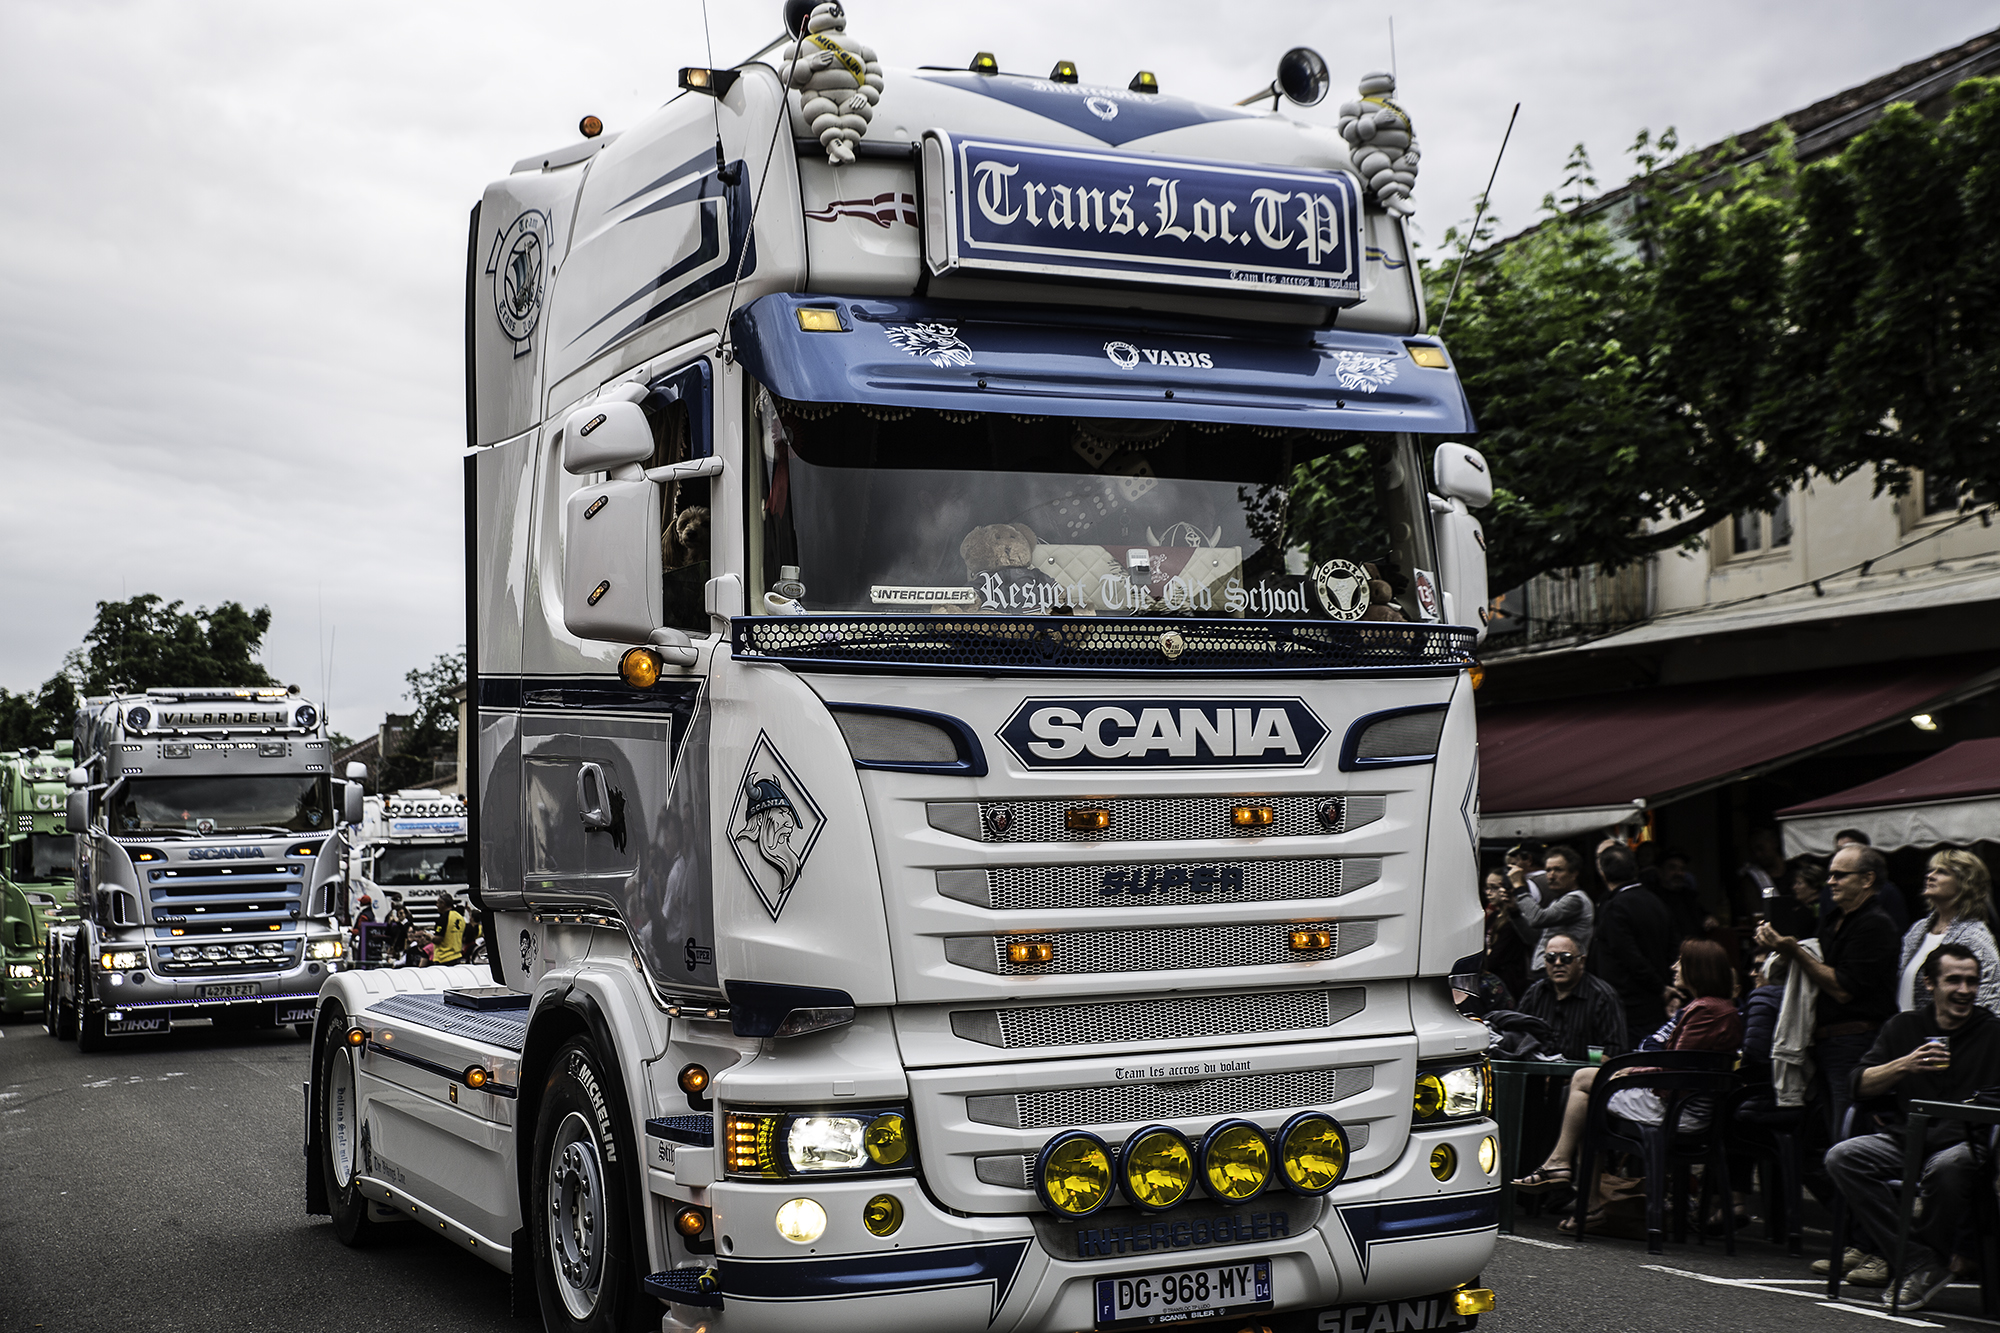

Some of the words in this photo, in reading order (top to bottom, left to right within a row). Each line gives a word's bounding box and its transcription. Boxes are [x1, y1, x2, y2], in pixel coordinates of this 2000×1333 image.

[1229, 269, 1258, 283] Team
[1262, 272, 1277, 284] les
[1142, 349, 1214, 369] VABIS
[1320, 560, 1364, 585] SCANIA
[878, 589, 969, 600] INTERCOOLER
[979, 572, 1088, 615] Respect
[1100, 573, 1151, 616] The
[1163, 575, 1212, 611] Old
[1224, 577, 1310, 618] School
[1327, 601, 1366, 620] VABIS
[164, 711, 284, 724] VILARDELL
[1028, 706, 1302, 760] SCANIA
[750, 798, 786, 815] SCANIA
[188, 846, 265, 860] SCANIA
[1102, 868, 1244, 896] SUPER
[408, 889, 447, 897] SCANIA
[207, 986, 232, 997] 4278
[281, 1009, 316, 1021] STIHO
[1115, 1067, 1145, 1080] Team
[1149, 1066, 1165, 1077] les
[1168, 1064, 1200, 1076] accros
[1204, 1062, 1216, 1073] du
[1220, 1060, 1251, 1072] volant
[579, 1063, 617, 1162] MICHELIN
[1078, 1211, 1290, 1257] INTERCOOLER
[1118, 1266, 1250, 1310] DG-968-MY
[1256, 1283, 1269, 1297] 04
[1104, 1305, 1110, 1315] F
[1160, 1313, 1188, 1322] SCANIA
